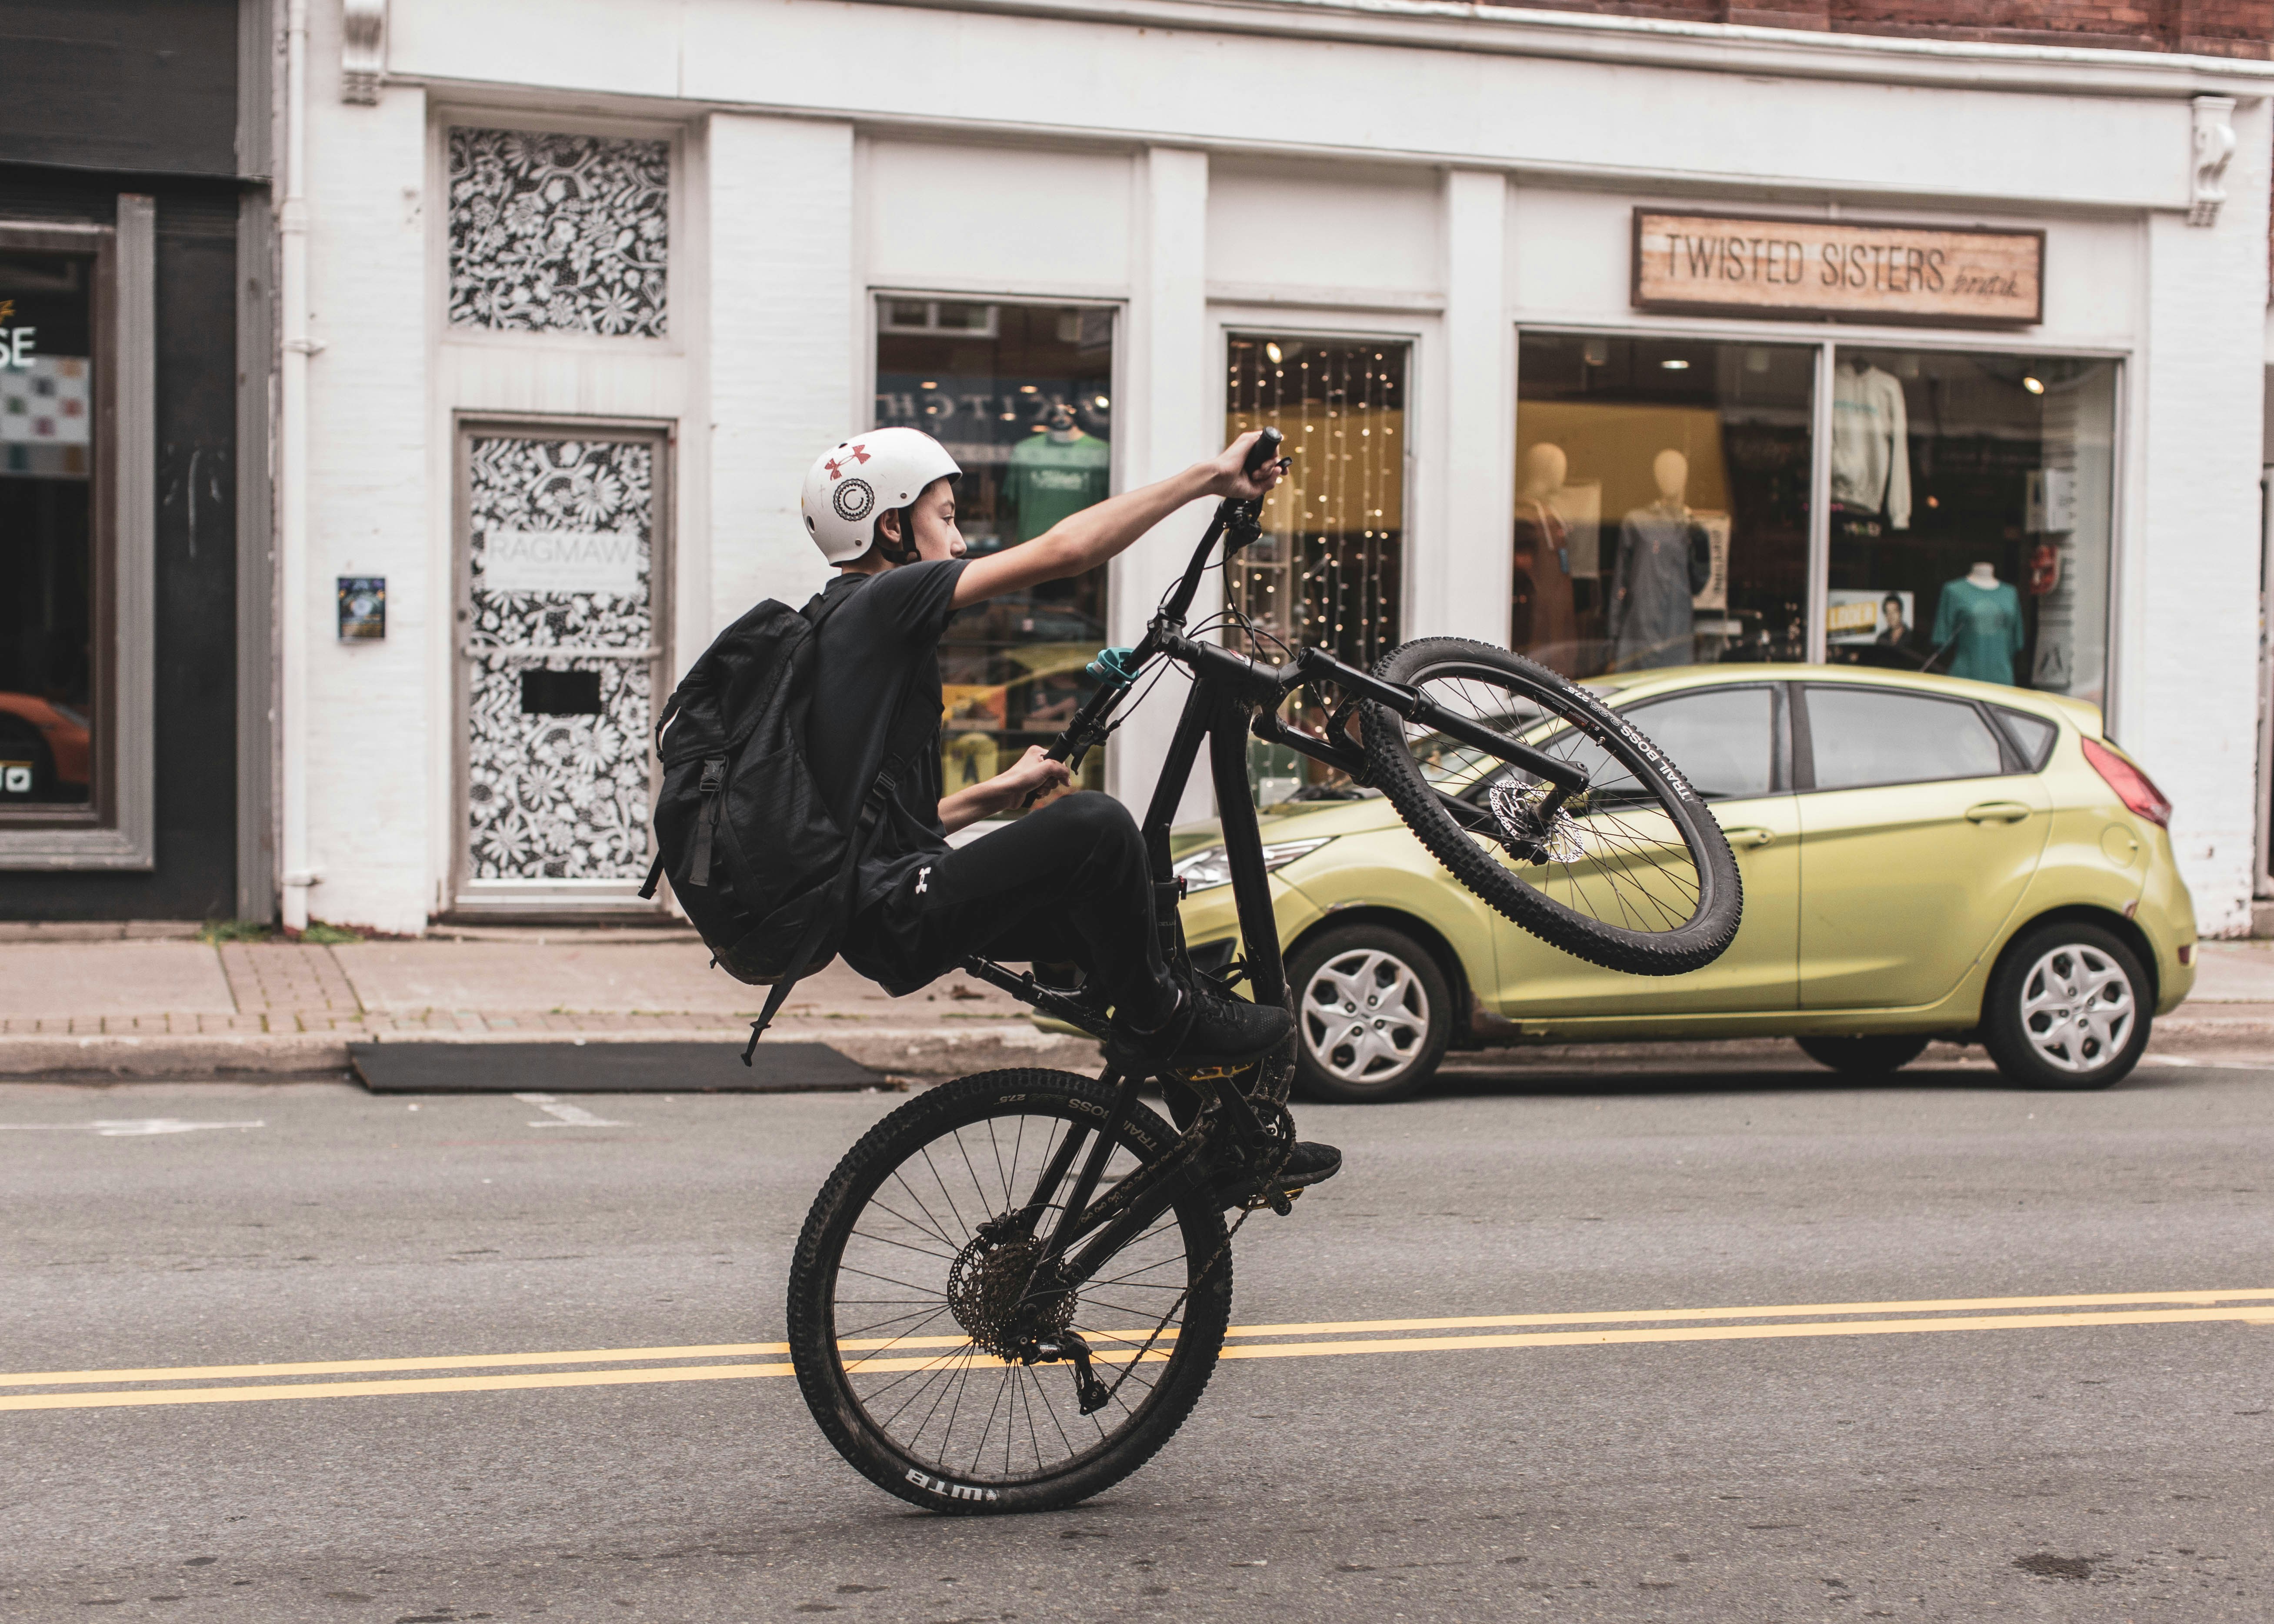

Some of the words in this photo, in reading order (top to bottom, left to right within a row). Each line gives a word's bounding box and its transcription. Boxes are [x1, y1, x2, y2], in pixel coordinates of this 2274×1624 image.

[1665, 233, 1804, 285] TWISTED
[1821, 242, 1945, 293] SISTERS
[489, 535, 632, 564] RAGMAW
[1589, 701, 1623, 726] 2.25
[1620, 725, 1660, 762] BOSS
[1659, 760, 1691, 800] TRAIL
[905, 1468, 983, 1501] WTB
